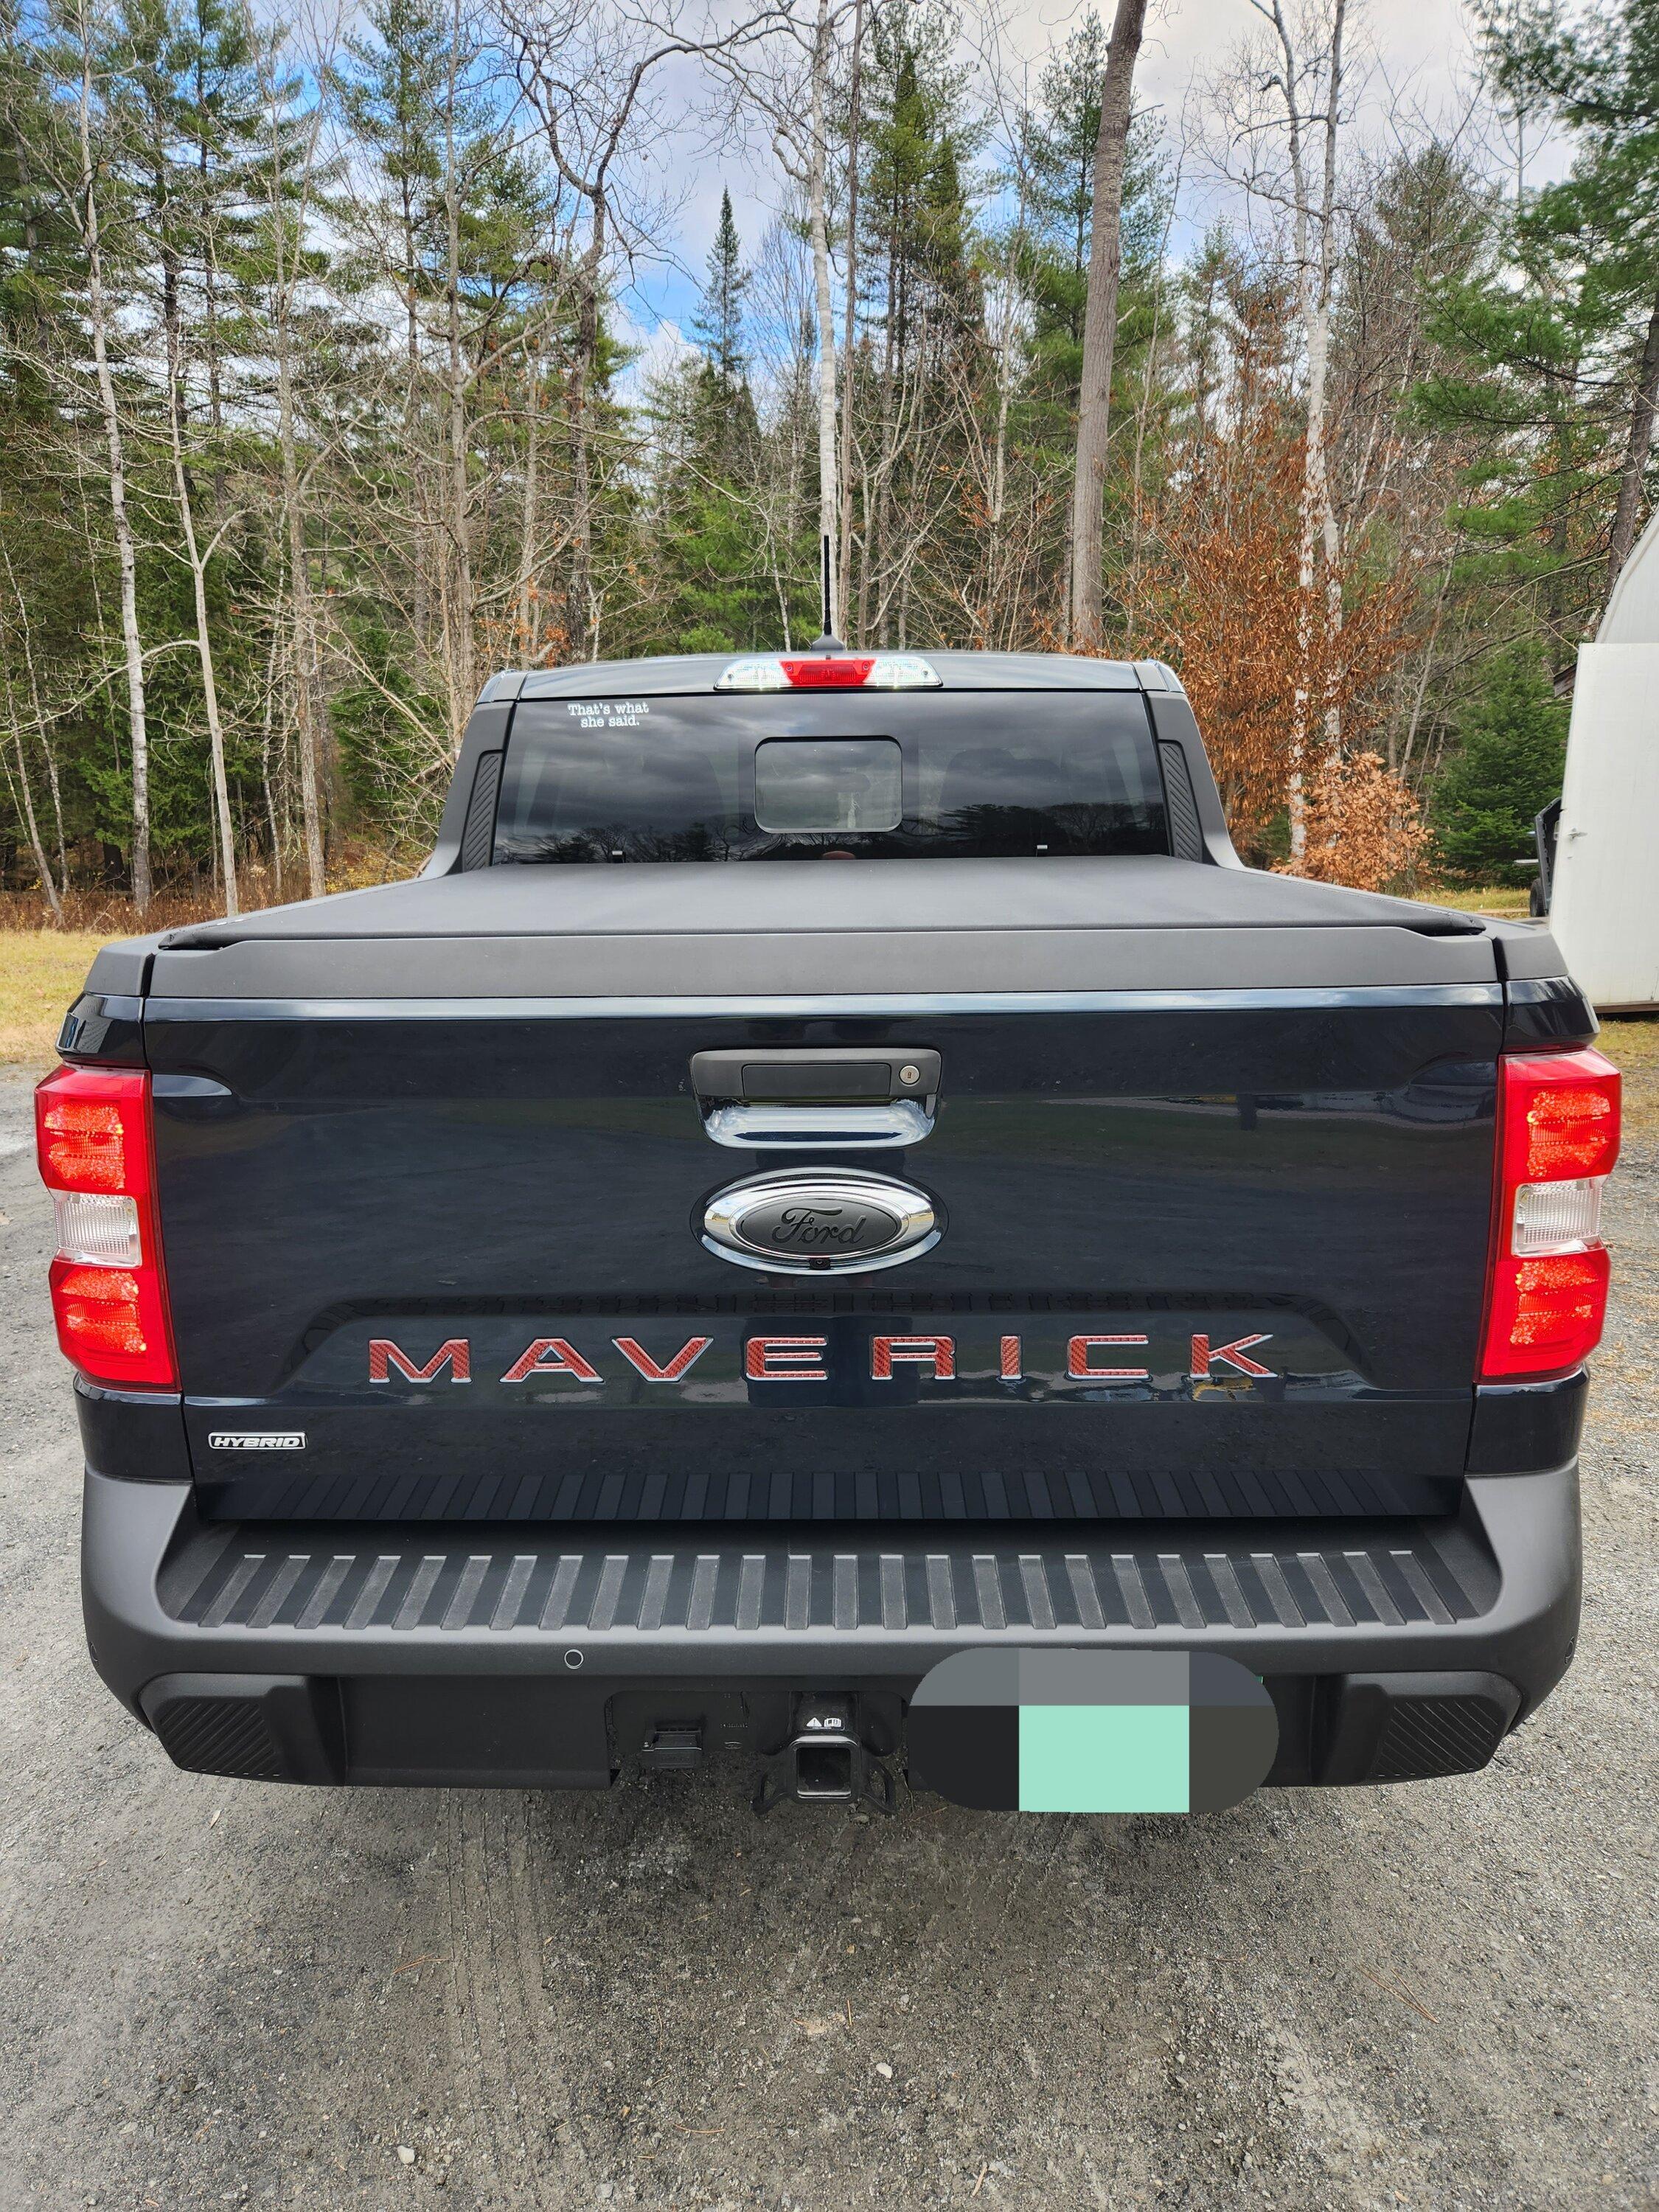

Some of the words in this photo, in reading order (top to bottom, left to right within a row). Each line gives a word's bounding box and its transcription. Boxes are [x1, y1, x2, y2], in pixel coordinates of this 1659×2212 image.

[567, 703, 611, 716] That's
[614, 701, 650, 714] what
[580, 716, 605, 728] she
[608, 714, 640, 727] said.
[771, 1206, 866, 1245] Ford
[368, 1333, 1279, 1384] MAVERICK
[214, 1437, 300, 1447] HYBRID
